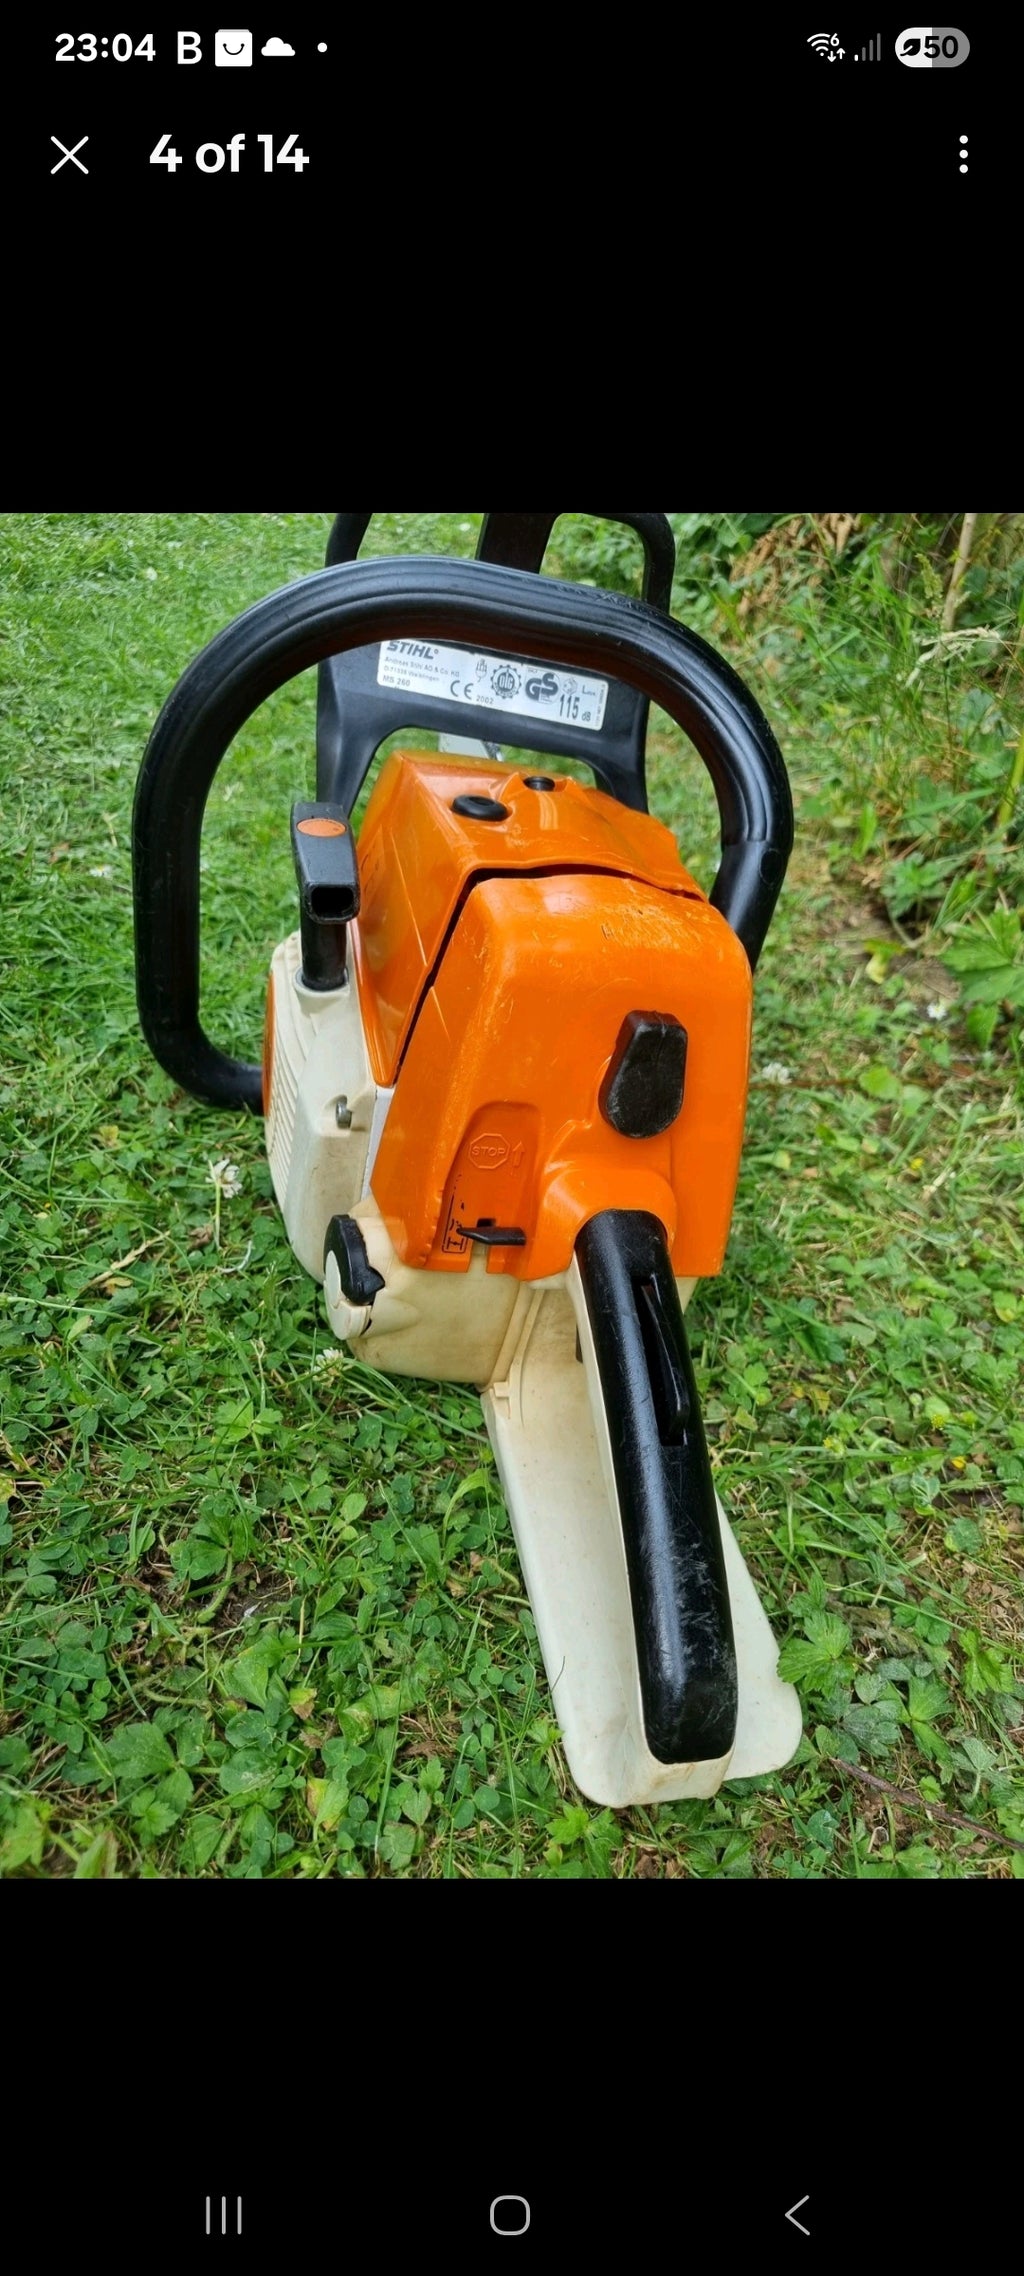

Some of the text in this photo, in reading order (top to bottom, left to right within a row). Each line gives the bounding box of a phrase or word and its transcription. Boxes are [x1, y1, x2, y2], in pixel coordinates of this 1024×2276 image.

[396, 677, 411, 687] 260
[525, 672, 559, 702] GS
[476, 694, 494, 705] 2002
[559, 693, 580, 720] 115
[582, 711, 592, 722] dB
[471, 1145, 506, 1157] STOP
